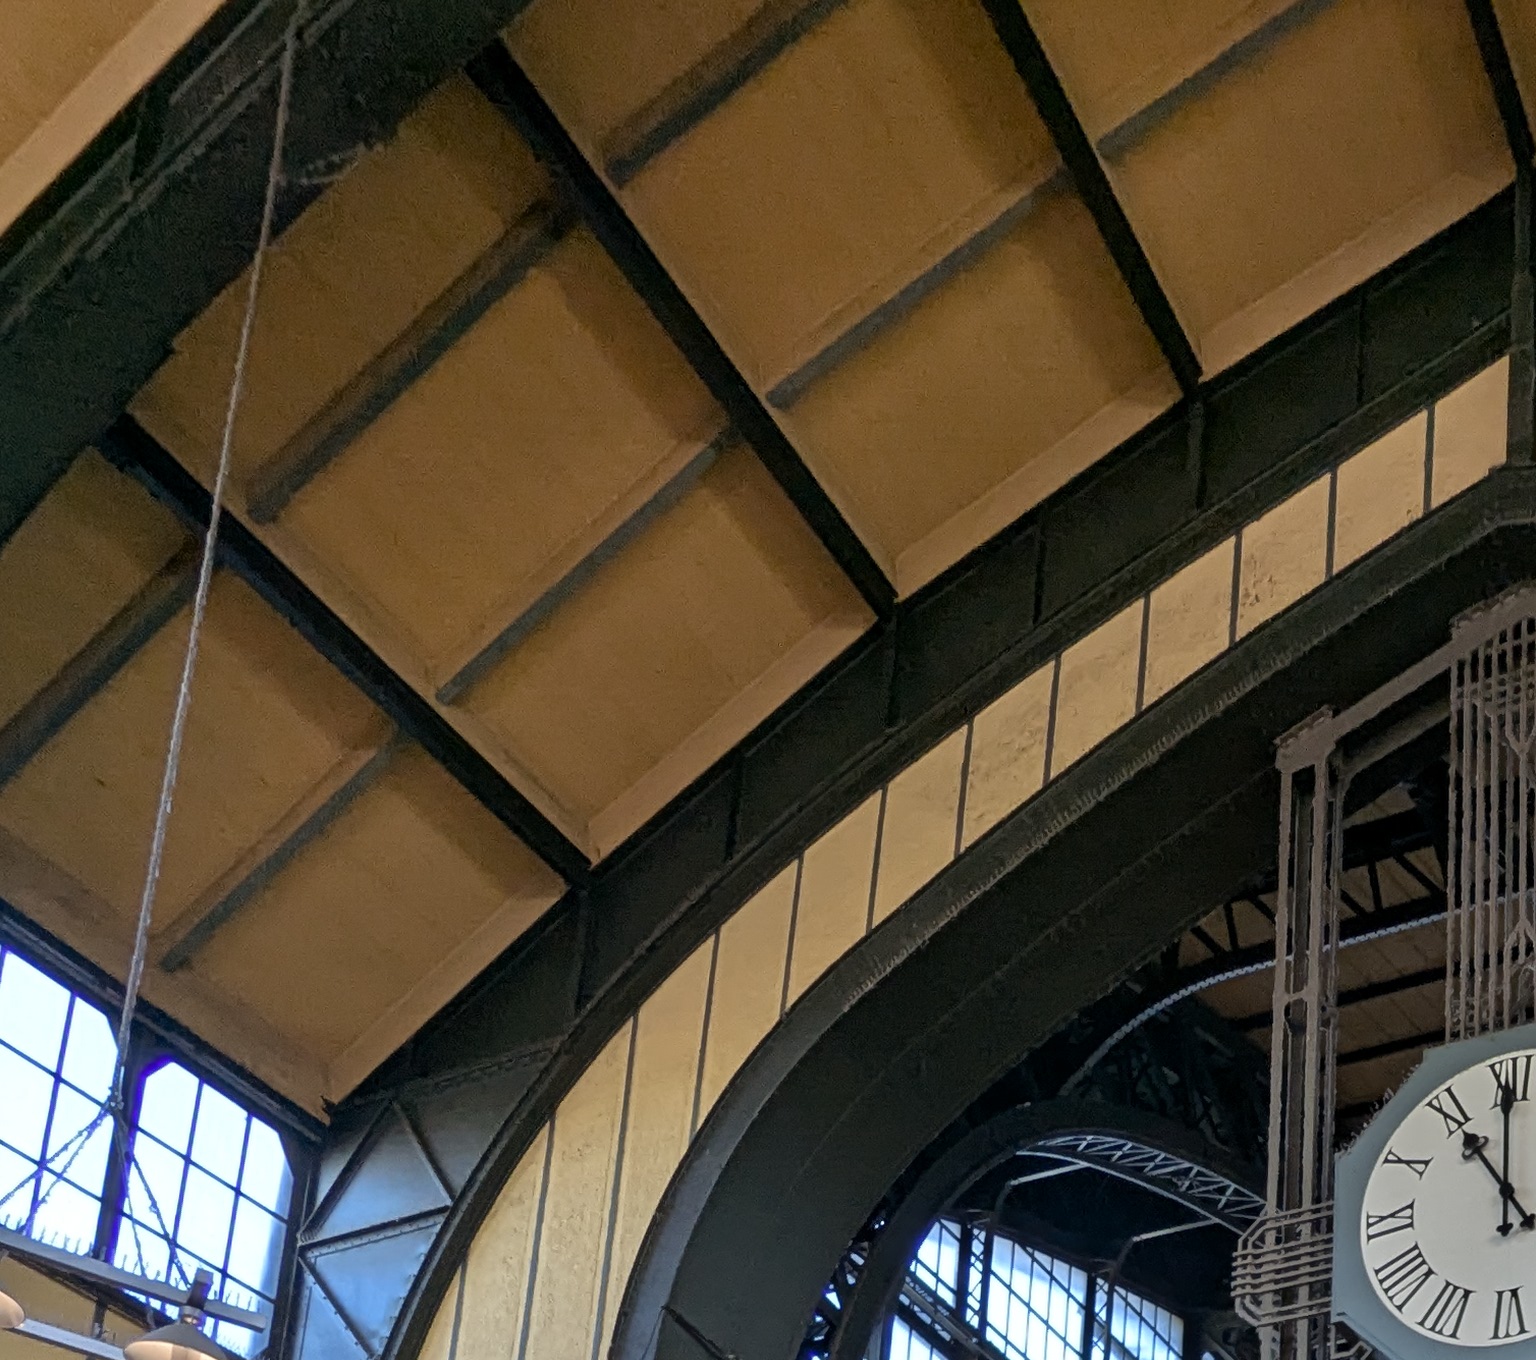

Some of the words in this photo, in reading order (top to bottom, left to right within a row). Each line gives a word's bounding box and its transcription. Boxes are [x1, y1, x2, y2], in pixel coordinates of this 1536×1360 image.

[1487, 1054, 1535, 1110] XII
[1423, 1084, 1473, 1139] XI
[1381, 1147, 1434, 1180] X
[1366, 1198, 1416, 1245] IX
[1373, 1241, 1438, 1314] VIII
[1415, 1279, 1476, 1340] VII
[1489, 1285, 1530, 1340] VI
